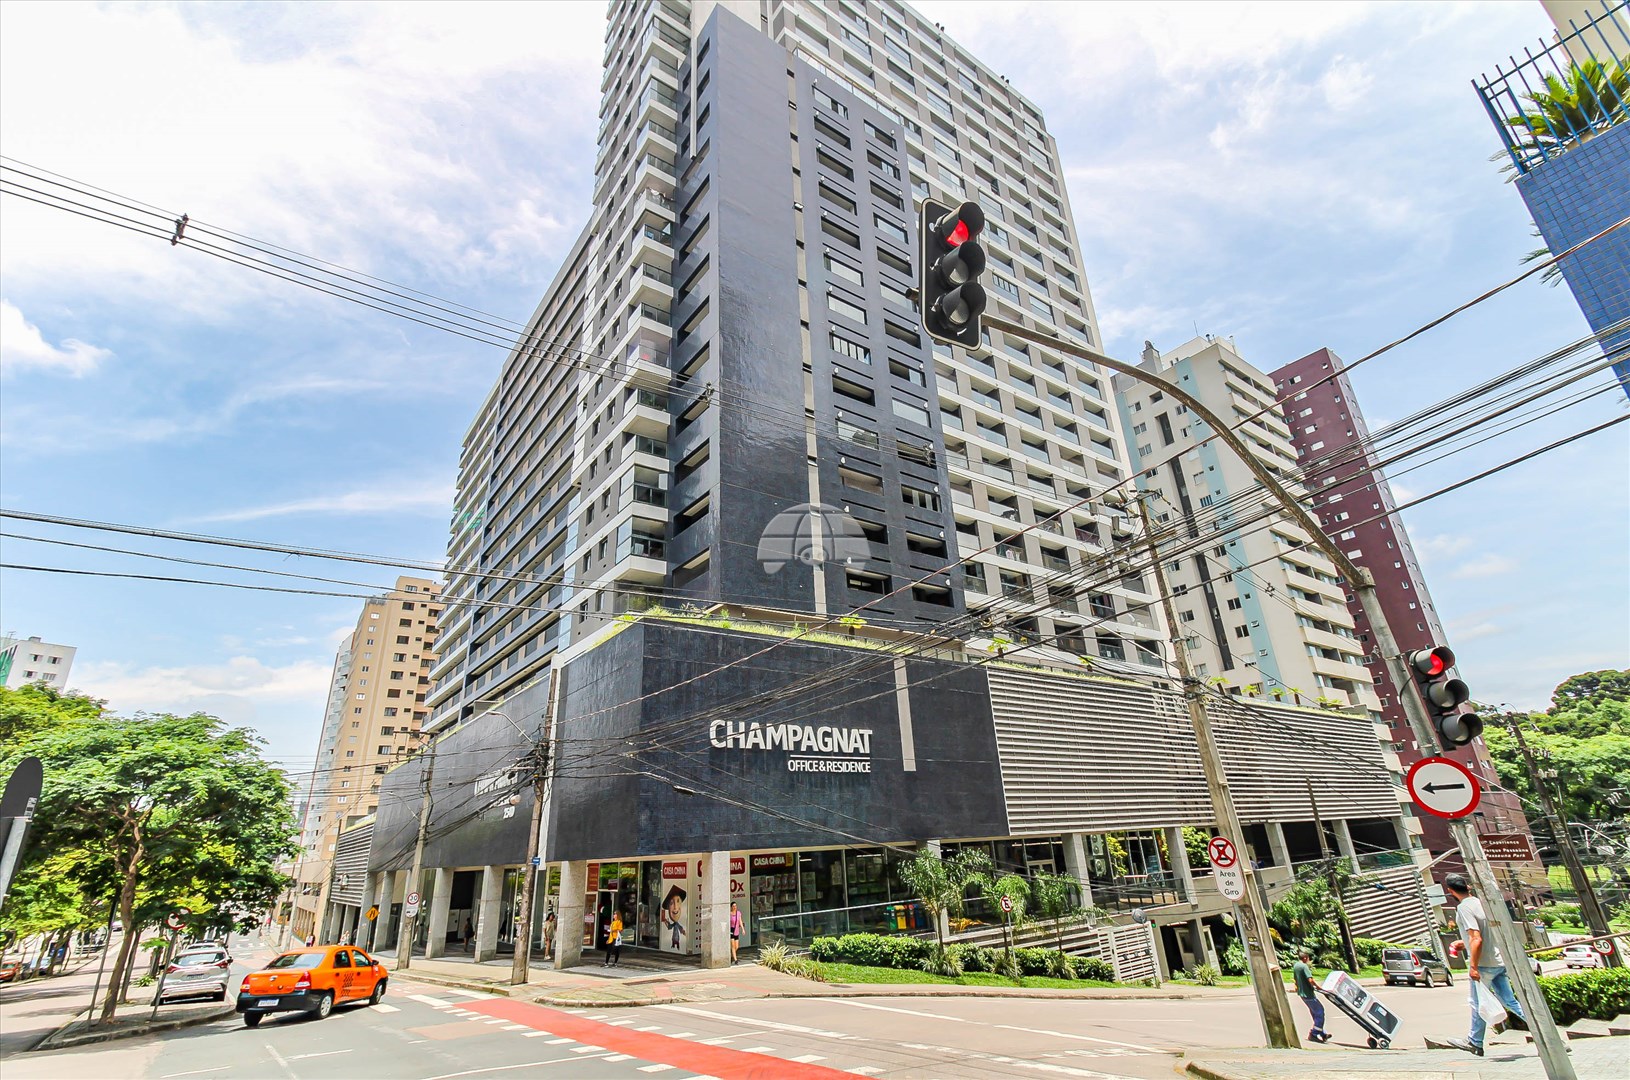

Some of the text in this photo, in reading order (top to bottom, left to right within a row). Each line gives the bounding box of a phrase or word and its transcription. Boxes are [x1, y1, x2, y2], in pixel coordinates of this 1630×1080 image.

[709, 719, 873, 754] CHAMPAGNAT
[754, 857, 768, 866] CASA
[769, 856, 785, 865] CHINA
[664, 866, 686, 875] CASA CHINA
[730, 862, 742, 870] INA
[730, 879, 744, 892] 0x
[1595, 941, 1609, 949] 50
